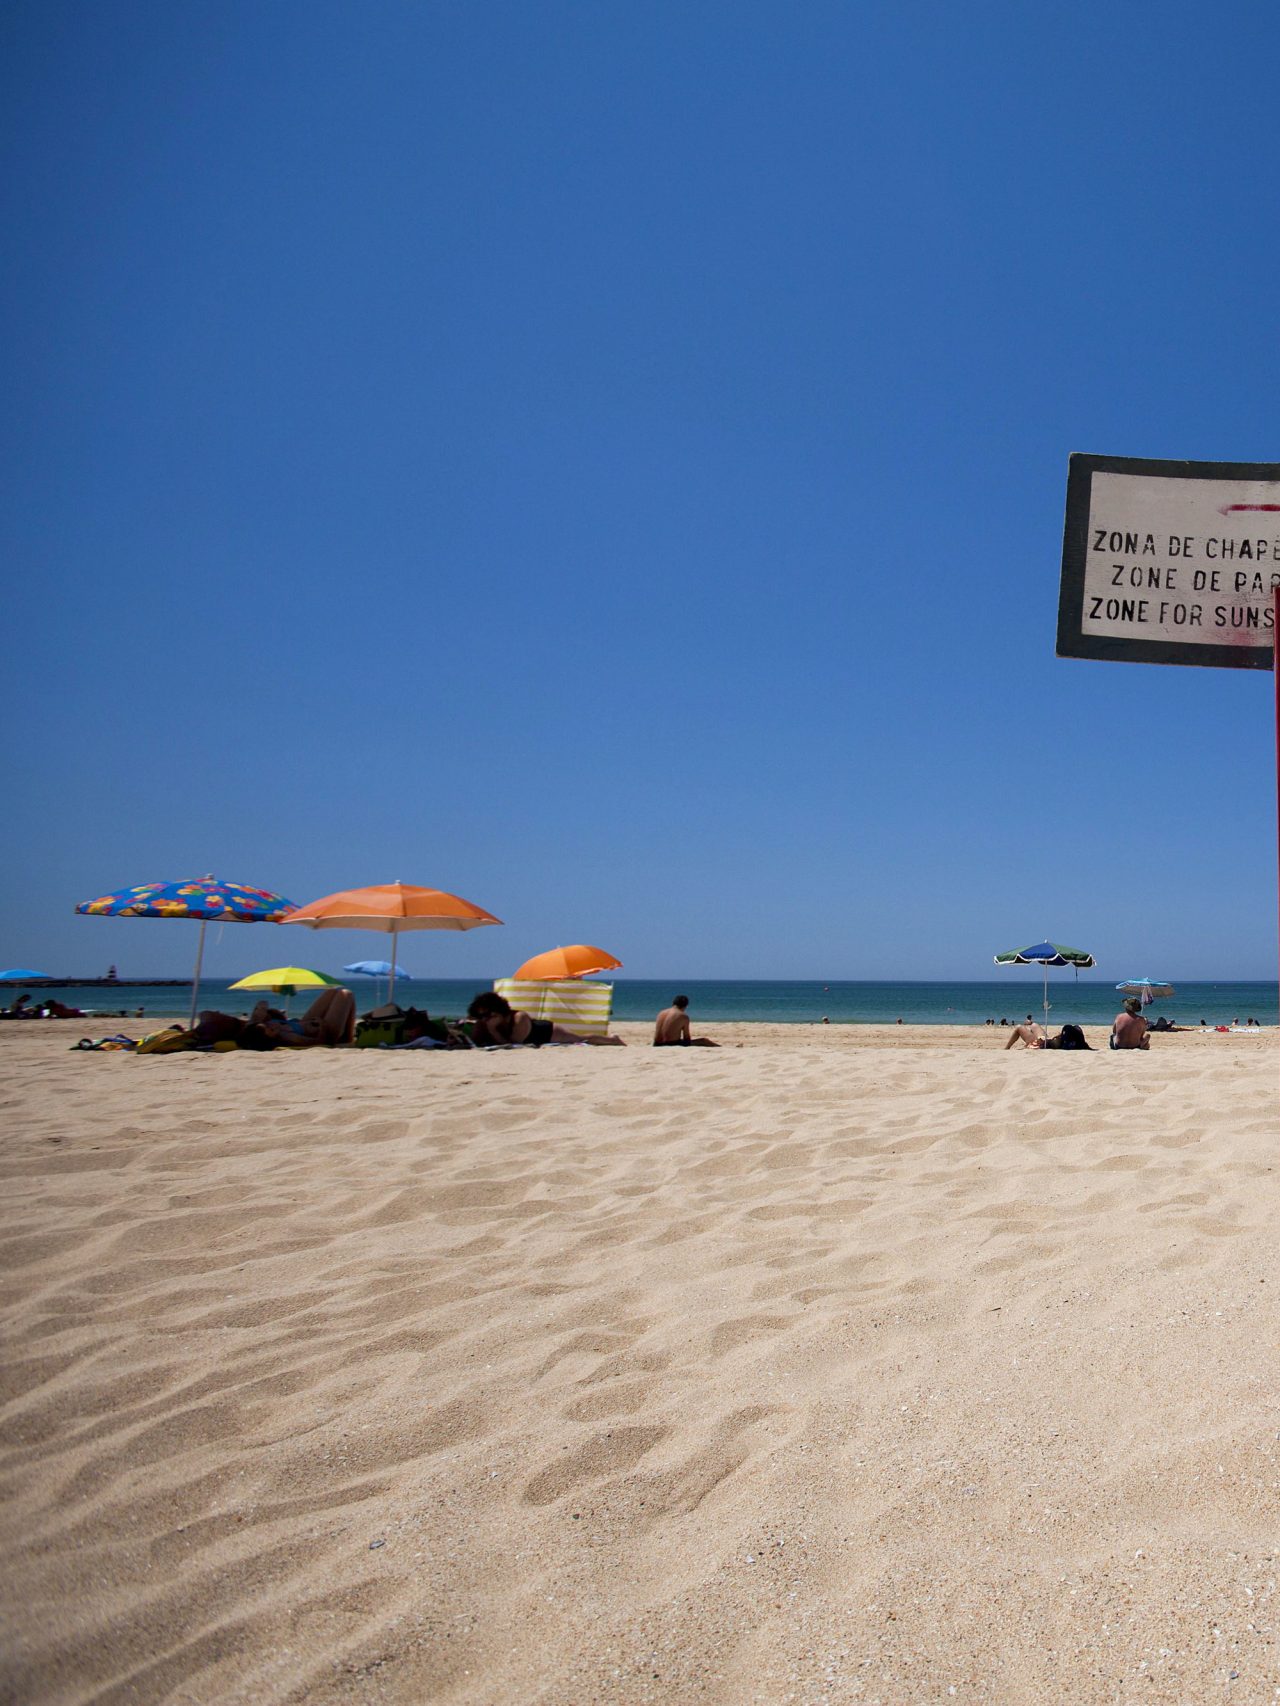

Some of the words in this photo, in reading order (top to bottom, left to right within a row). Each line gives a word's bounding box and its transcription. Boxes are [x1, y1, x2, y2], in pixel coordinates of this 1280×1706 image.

[1093, 530, 1156, 555] ZONA
[1168, 536, 1195, 558] DE
[1111, 564, 1177, 590] ZONE
[1193, 570, 1221, 592] DE
[1089, 597, 1149, 623] ZONE
[1159, 602, 1203, 626] FOR
